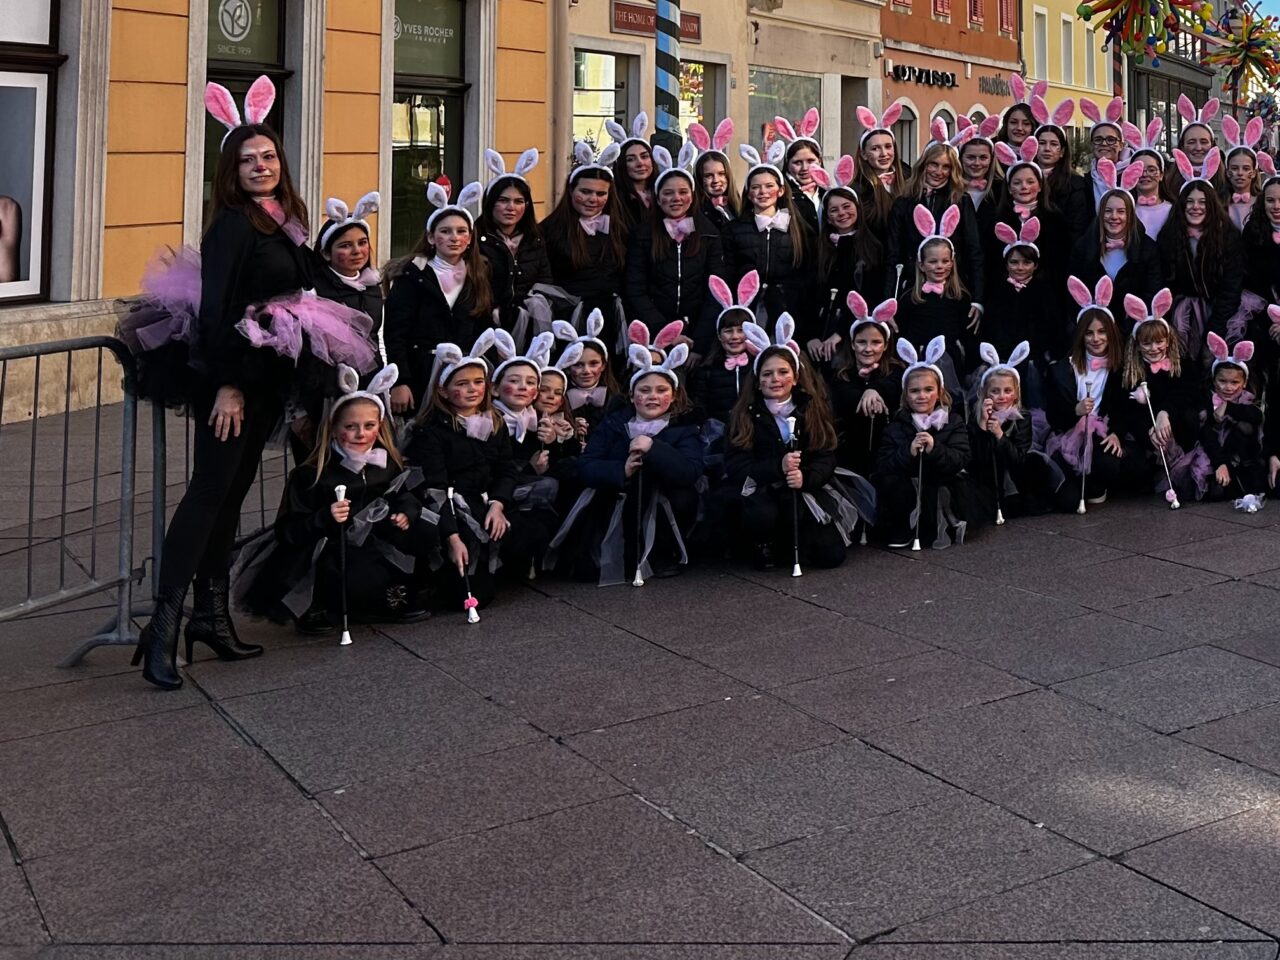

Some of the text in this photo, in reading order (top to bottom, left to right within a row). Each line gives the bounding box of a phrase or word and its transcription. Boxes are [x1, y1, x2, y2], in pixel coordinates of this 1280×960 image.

[615, 10, 627, 23] THE
[647, 15, 655, 27] OF
[403, 23, 454, 38] YVES ROCHER
